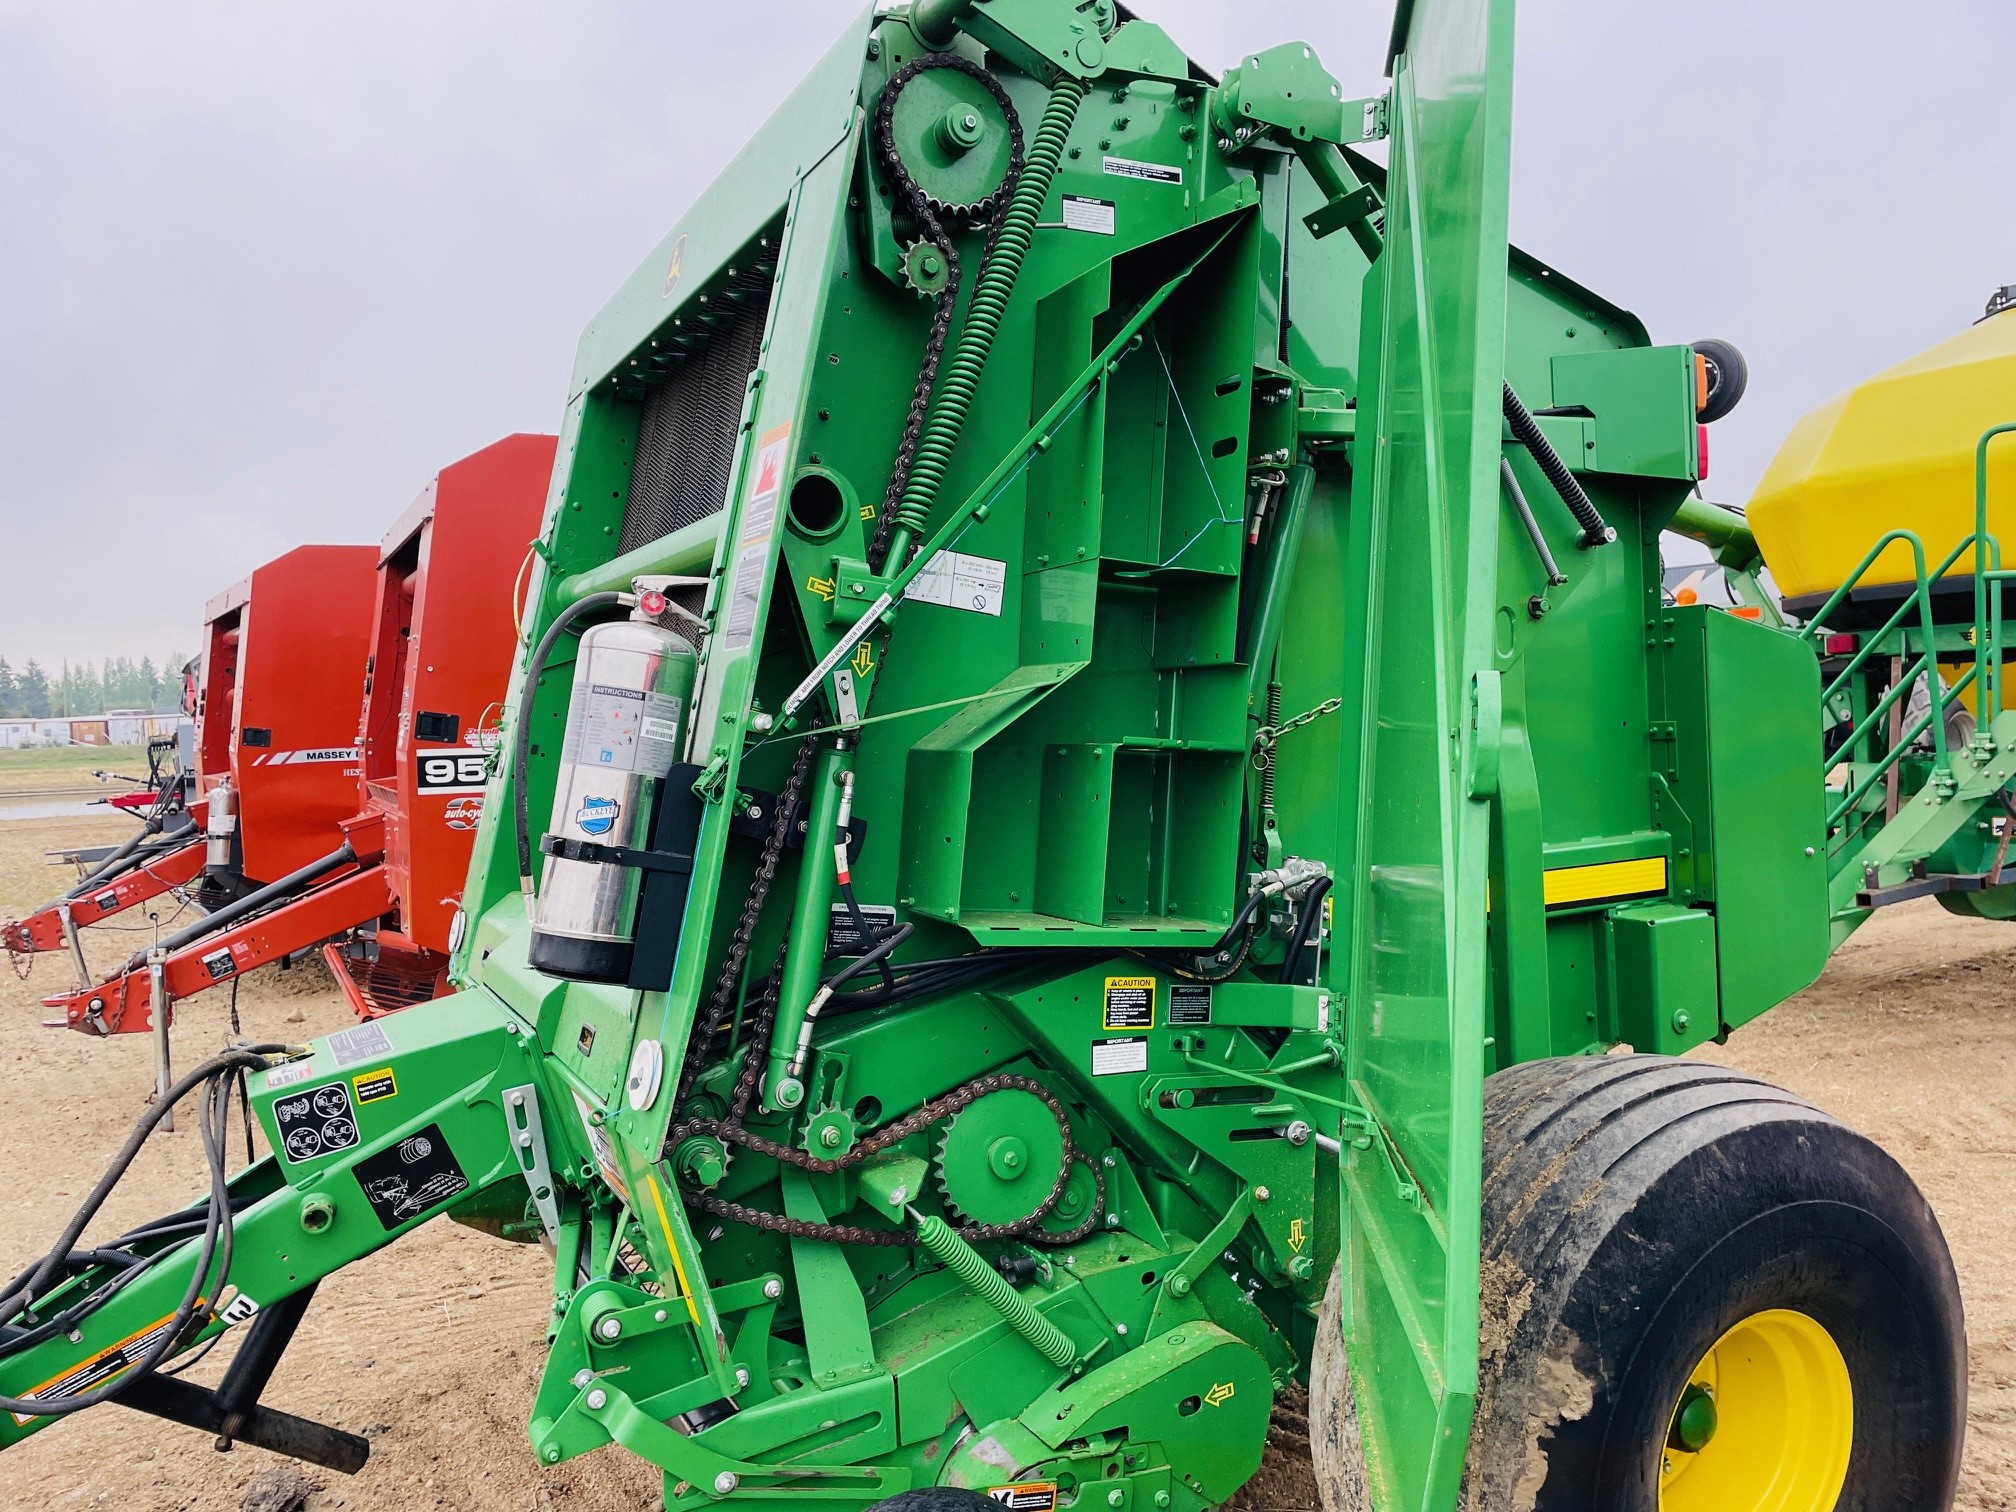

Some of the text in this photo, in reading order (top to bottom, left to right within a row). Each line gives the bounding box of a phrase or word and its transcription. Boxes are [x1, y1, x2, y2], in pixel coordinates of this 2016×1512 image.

[834, 645, 844, 657] AND
[842, 631, 858, 648] LOWER
[861, 609, 878, 627] THREAD
[594, 687, 642, 699] INSTRUCTIONS
[306, 751, 352, 760] MASSEY
[582, 807, 614, 817] BUCKEYE
[1117, 979, 1151, 987] CAUTION
[361, 1071, 390, 1082] CAUTION
[103, 1334, 138, 1356] WARNING
